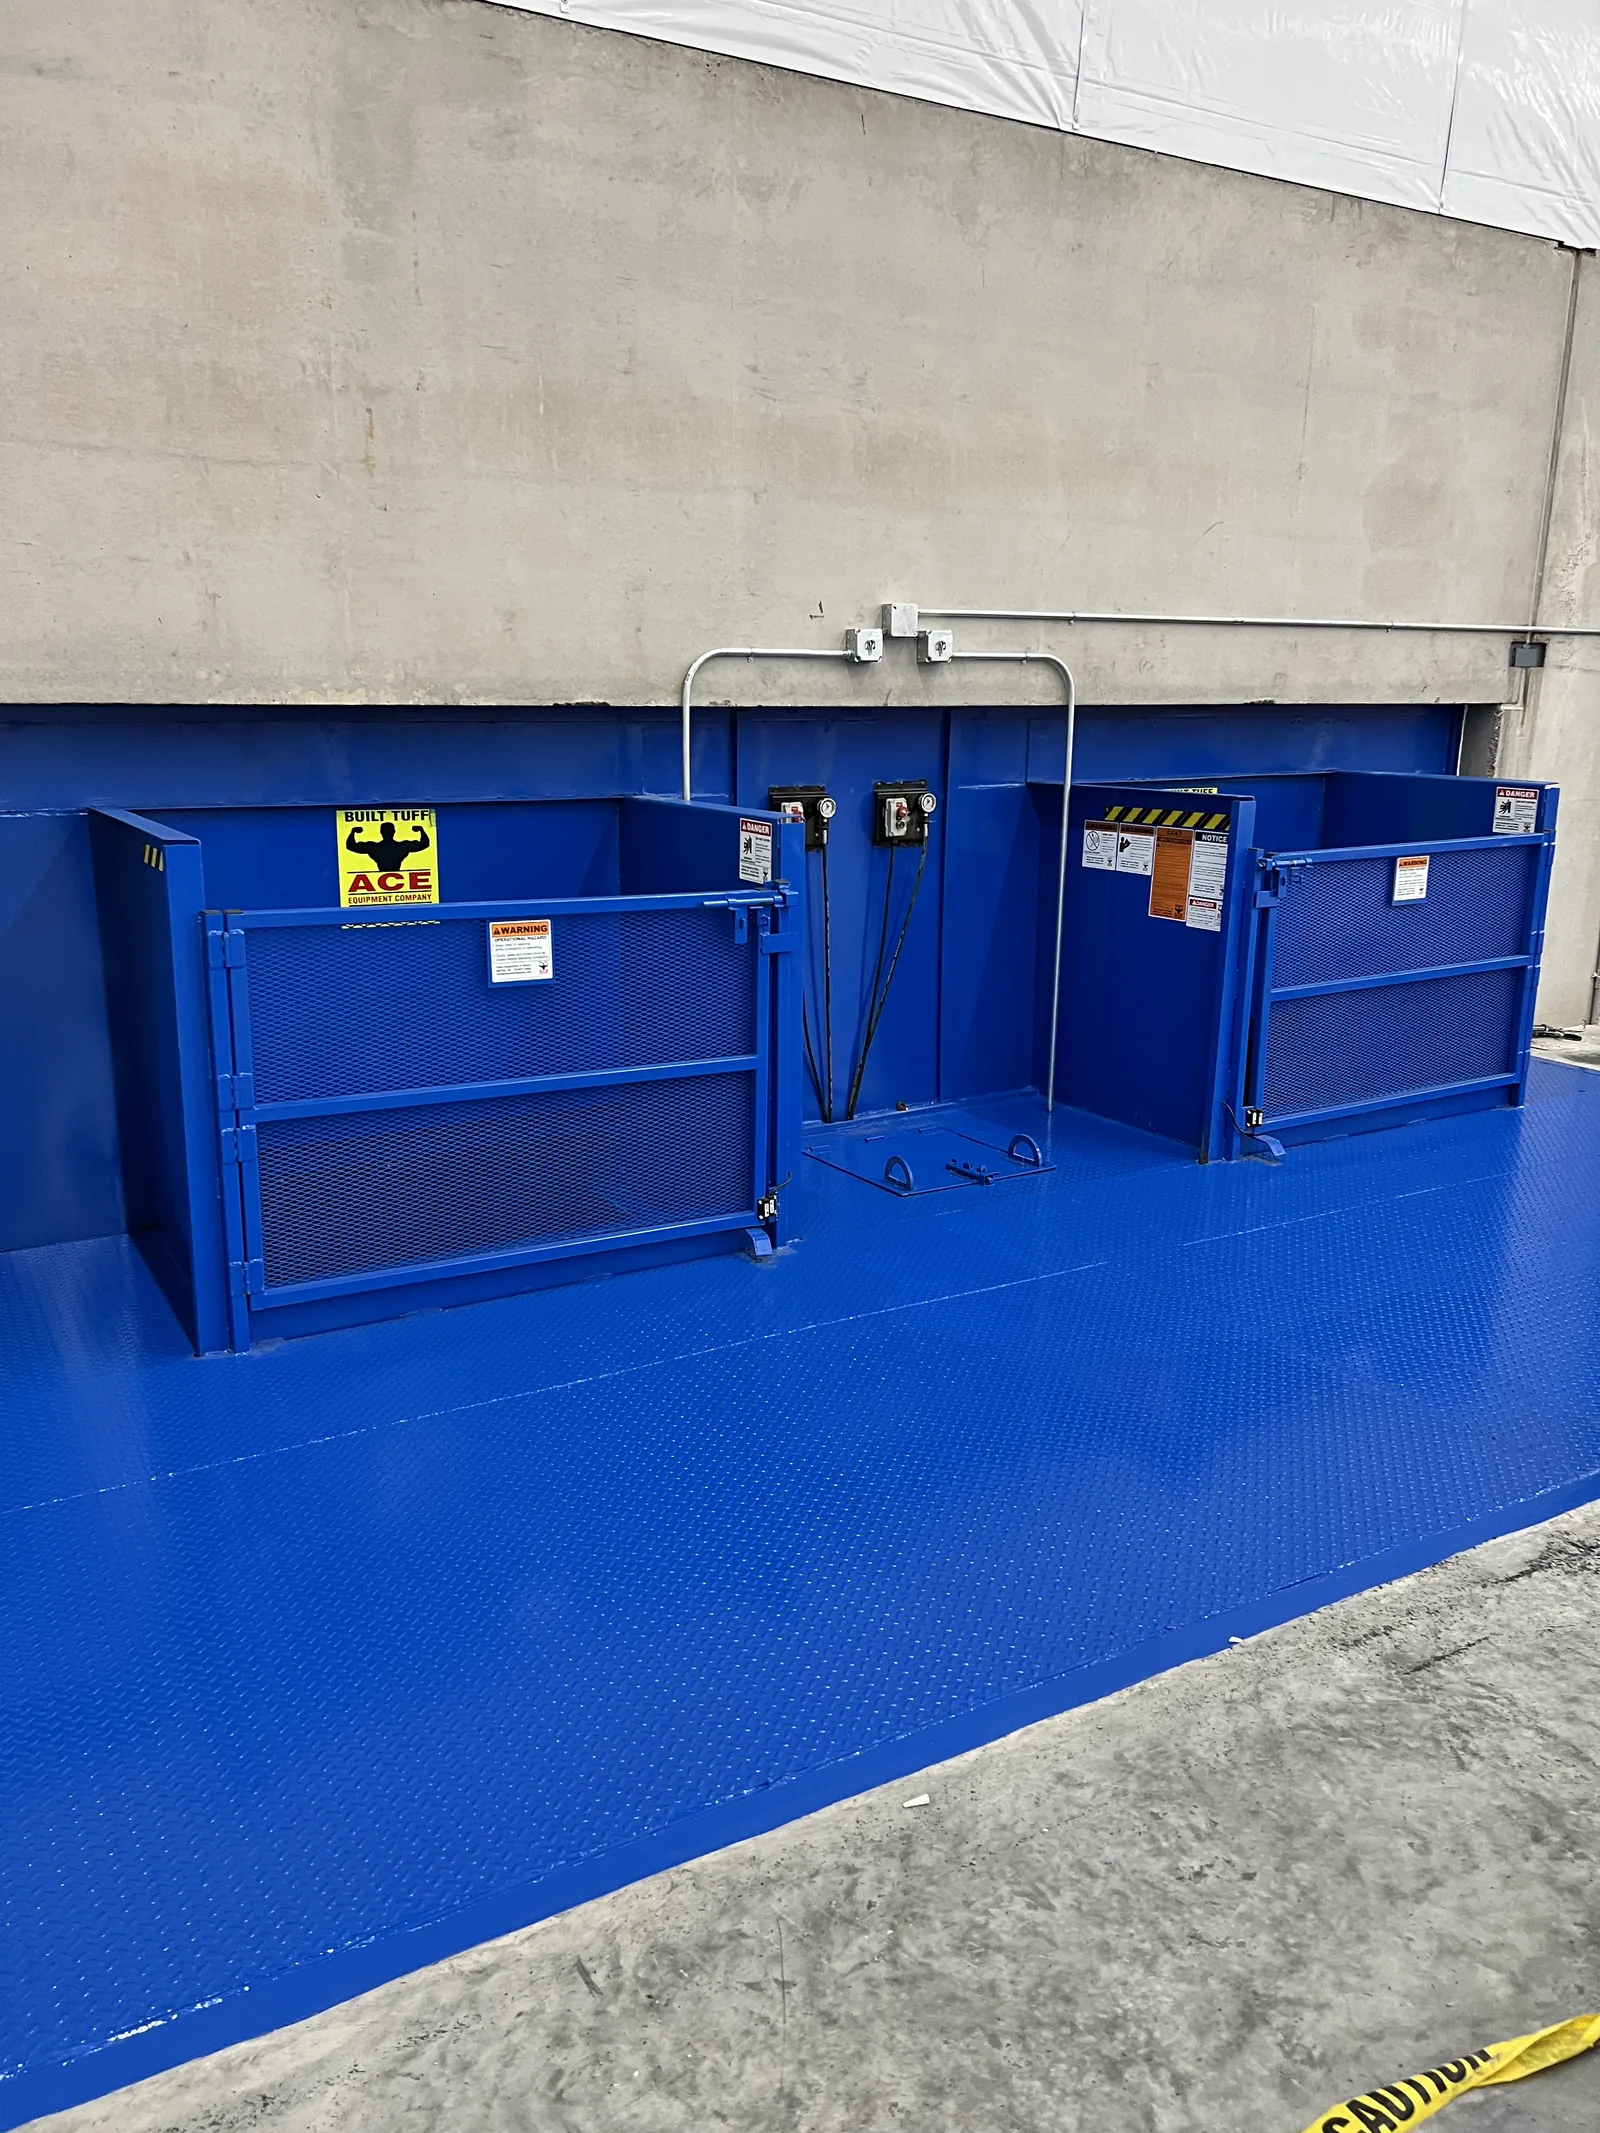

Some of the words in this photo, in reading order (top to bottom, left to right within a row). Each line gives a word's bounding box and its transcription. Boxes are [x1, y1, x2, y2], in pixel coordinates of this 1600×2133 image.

[1505, 790, 1536, 798] DANGER
[344, 811, 386, 822] BUILT
[391, 810, 429, 821] TUFF
[746, 822, 770, 835] DANGER
[1201, 833, 1228, 843] NOTICE
[348, 872, 432, 892] ACE
[348, 895, 392, 904] EQUIPMENT
[395, 893, 432, 903] COMPANY
[501, 925, 548, 934] WARNING
